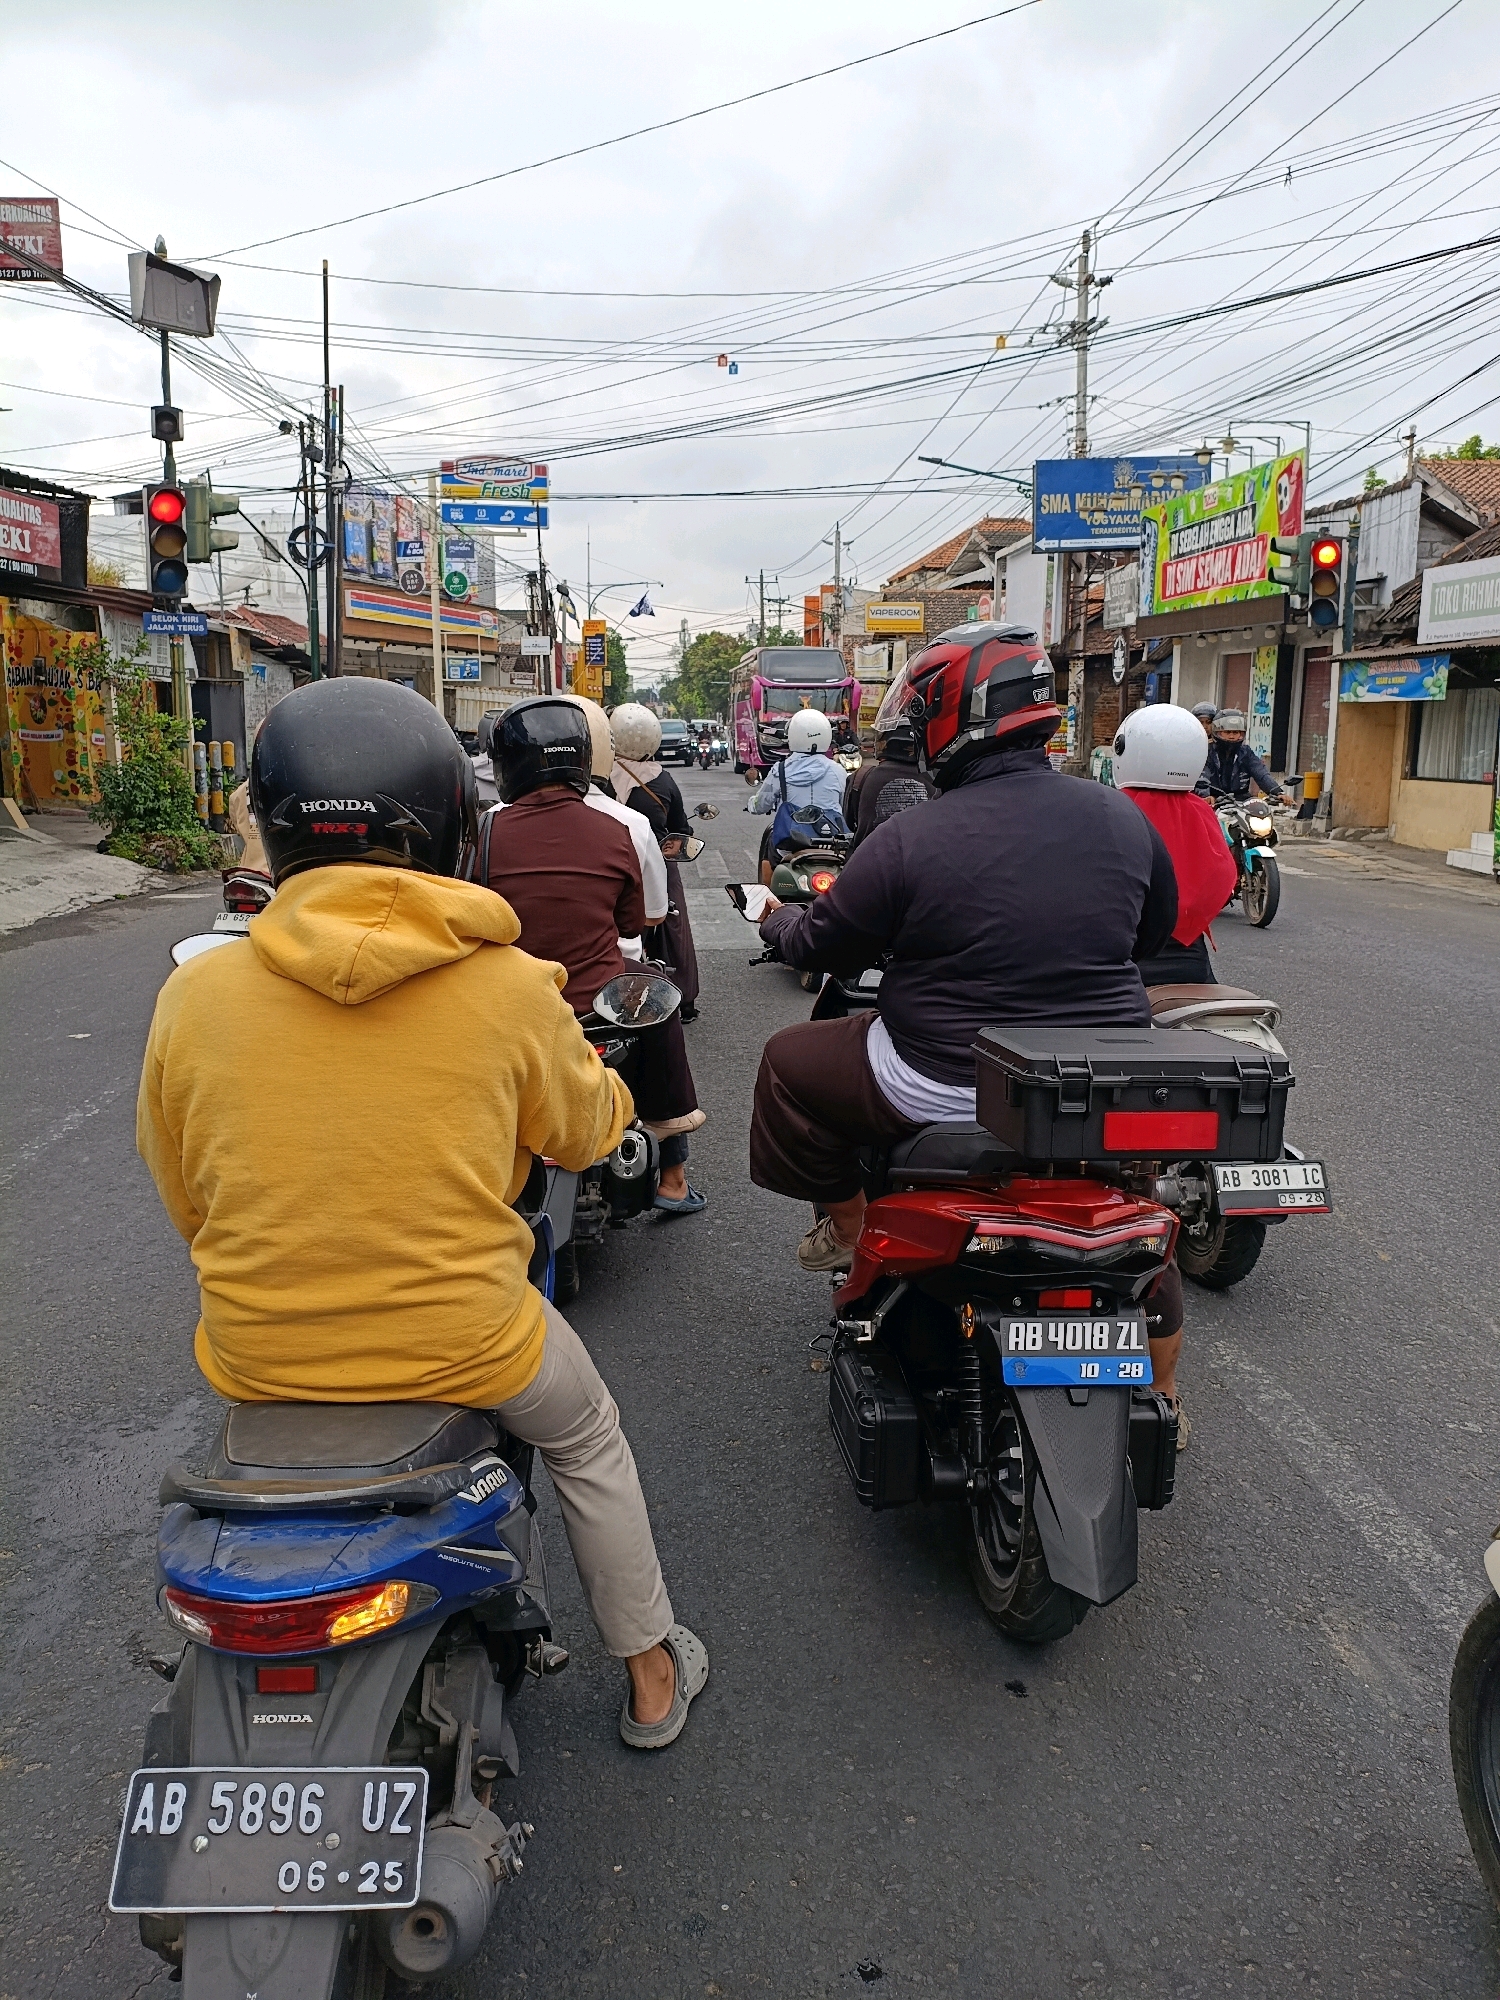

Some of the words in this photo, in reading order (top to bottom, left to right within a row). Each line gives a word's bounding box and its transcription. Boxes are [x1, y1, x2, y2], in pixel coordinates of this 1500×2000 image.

[0, 205, 52, 222] ERKUALITAS
[481, 481, 531, 499] Fresh
[1041, 493, 1071, 514] SMA
[1075, 489, 1196, 513] MUHAMMADIYA
[1179, 521, 1208, 554] SEBELAH
[1197, 548, 1233, 591] SEMUA
[1233, 541, 1263, 582] ADA!
[1434, 584, 1460, 616] TOKO
[151, 615, 179, 623] BELOK
[870, 608, 920, 616] VAPEROOM
[147, 624, 175, 632] JALAN
[543, 746, 576, 754] HONDA
[300, 800, 378, 813] HONDA
[1222, 1170, 1241, 1188] AB
[1251, 1168, 1290, 1187] 3081
[1303, 1167, 1320, 1185] IC
[1008, 1322, 1043, 1351] AB
[1048, 1322, 1110, 1351] 4018
[1116, 1322, 1144, 1350] ZL
[456, 1467, 508, 1504] VARIO
[252, 1714, 313, 1724] HONDA
[131, 1782, 187, 1835] AB
[207, 1781, 325, 1835] 5896
[362, 1781, 417, 1834] UZ
